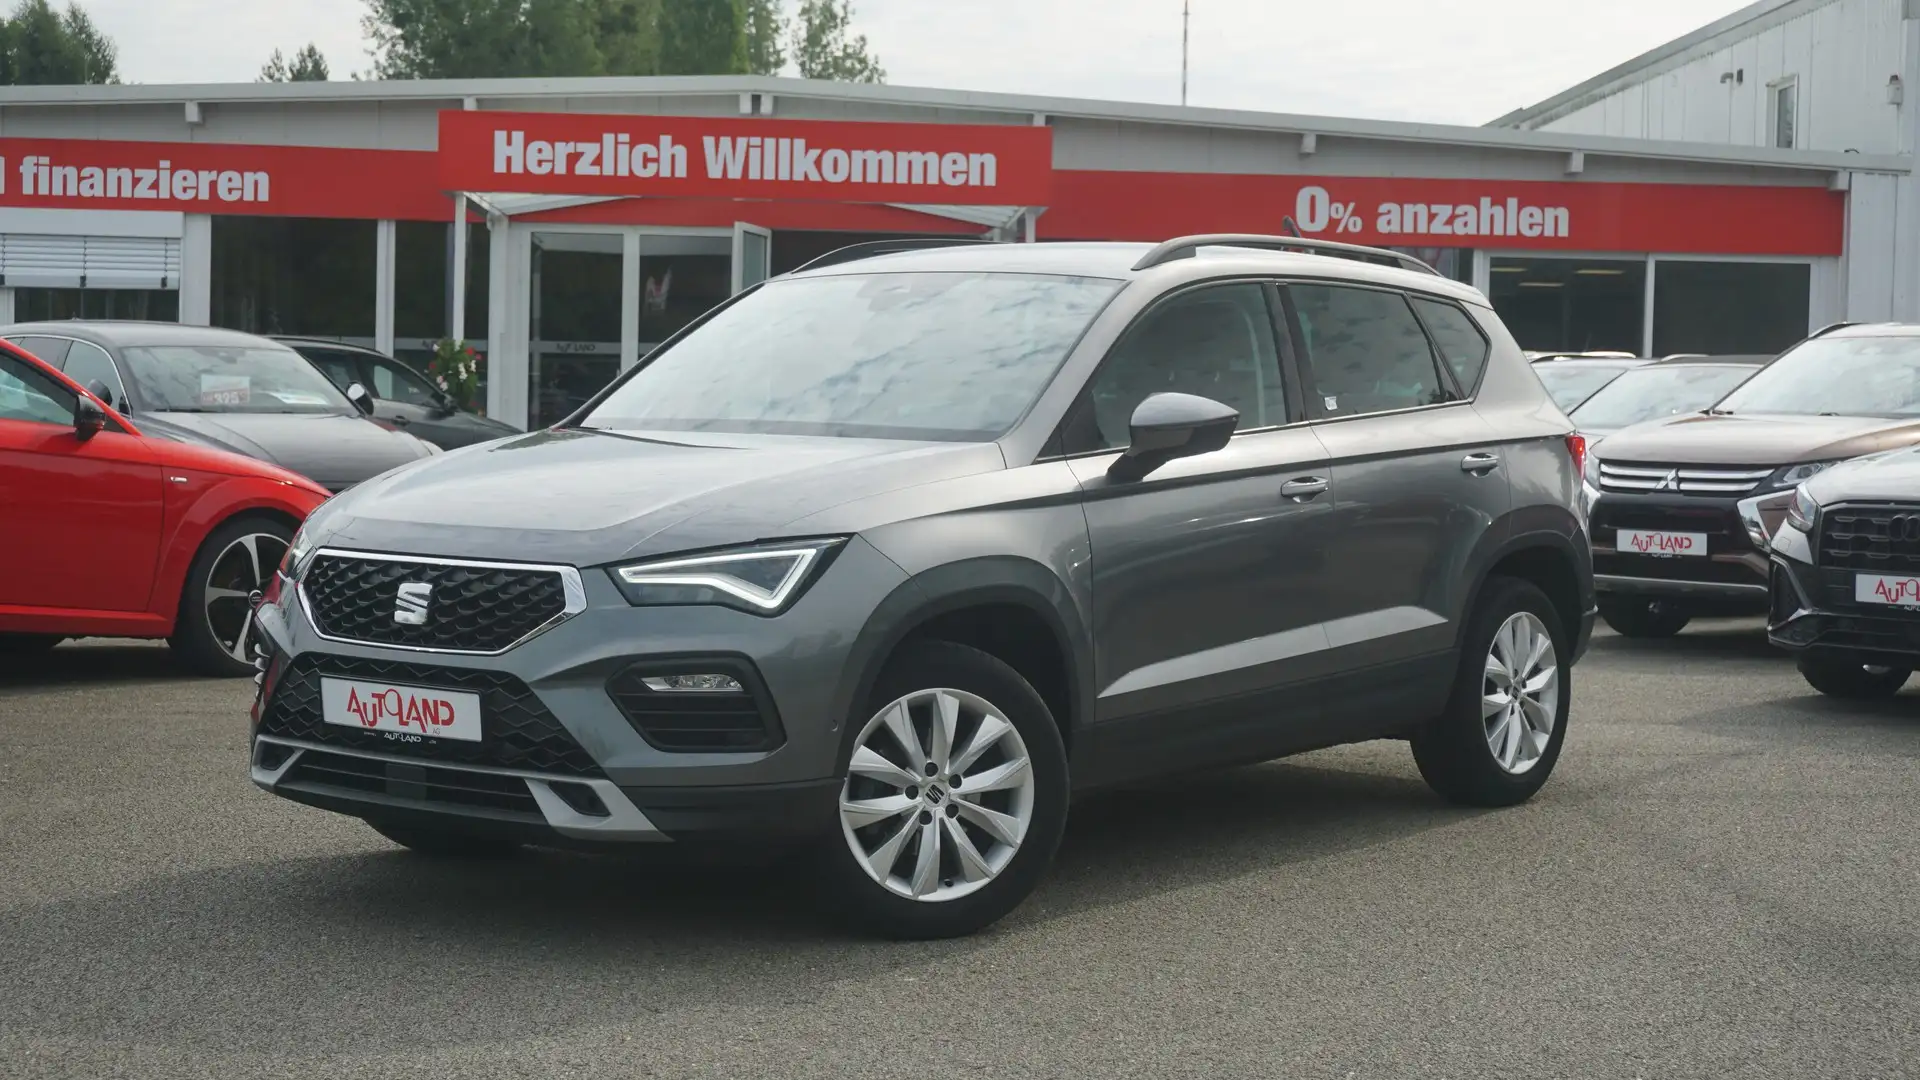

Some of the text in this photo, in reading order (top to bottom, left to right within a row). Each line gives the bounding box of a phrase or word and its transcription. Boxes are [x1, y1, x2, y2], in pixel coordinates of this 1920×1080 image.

[19, 156, 270, 202] finanzieren
[493, 130, 997, 186] Herzlich Willkommen
[1296, 186, 1569, 237] 0% anzahlen
[1631, 533, 1692, 552] AUTOLAND
[347, 686, 455, 733] AUTOLAND
